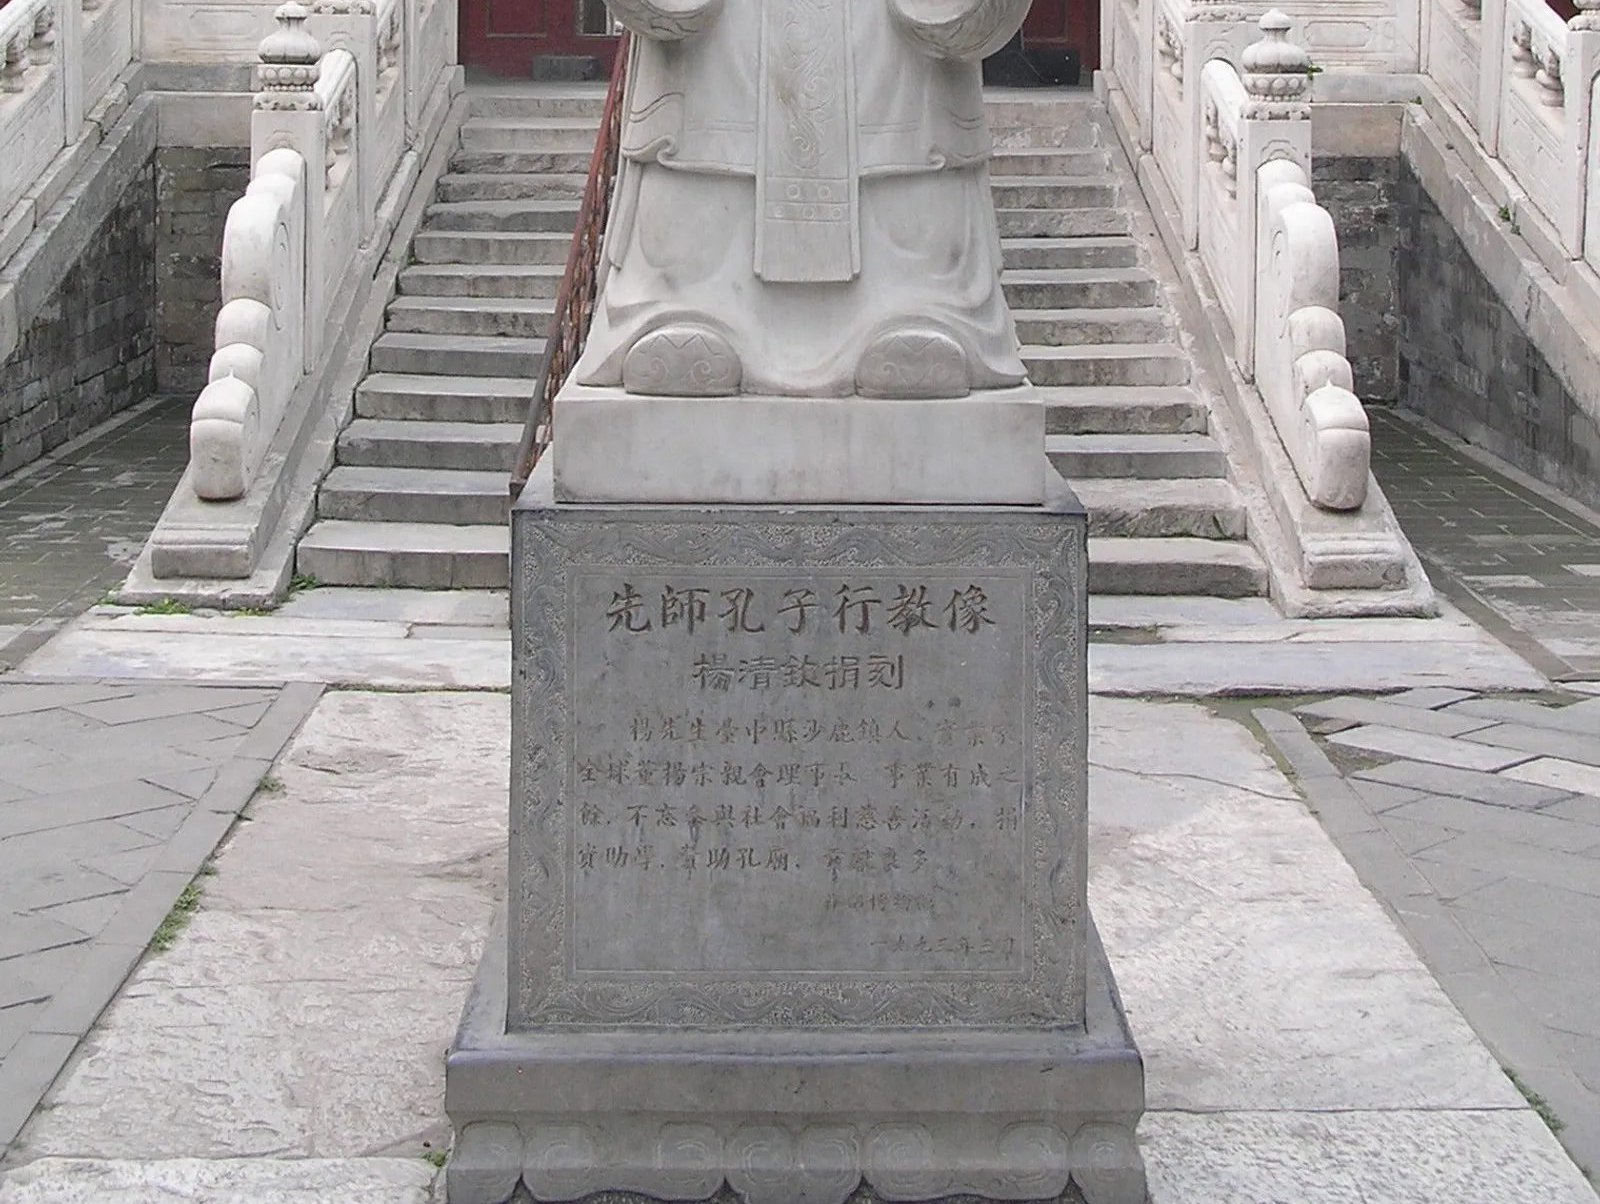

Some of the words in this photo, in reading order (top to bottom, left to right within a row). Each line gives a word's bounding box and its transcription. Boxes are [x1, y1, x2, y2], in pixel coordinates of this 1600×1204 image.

[607, 583, 996, 635] 先師孔子行教像
